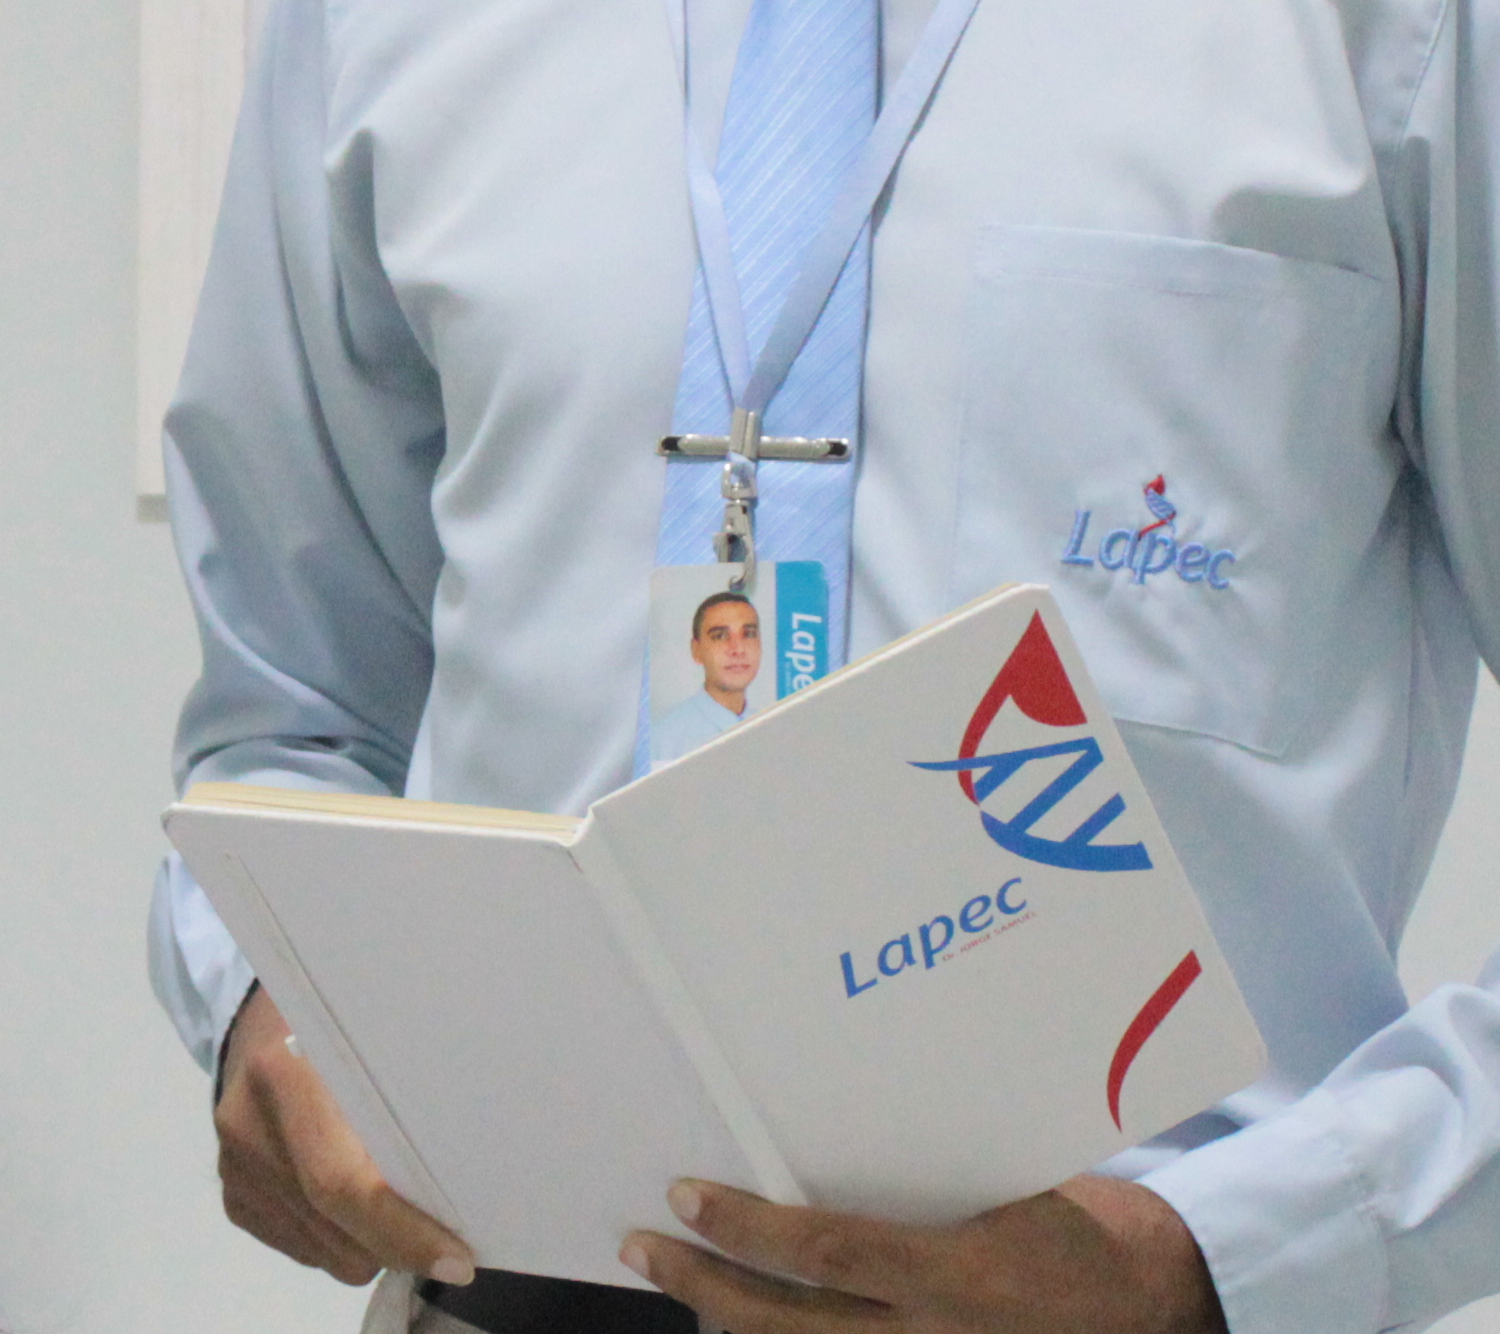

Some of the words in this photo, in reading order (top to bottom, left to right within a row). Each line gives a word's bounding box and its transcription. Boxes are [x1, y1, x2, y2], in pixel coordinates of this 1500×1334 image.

[1060, 509, 1237, 590] Lapec
[783, 612, 823, 692] Lape
[839, 876, 1028, 999] Lapec
